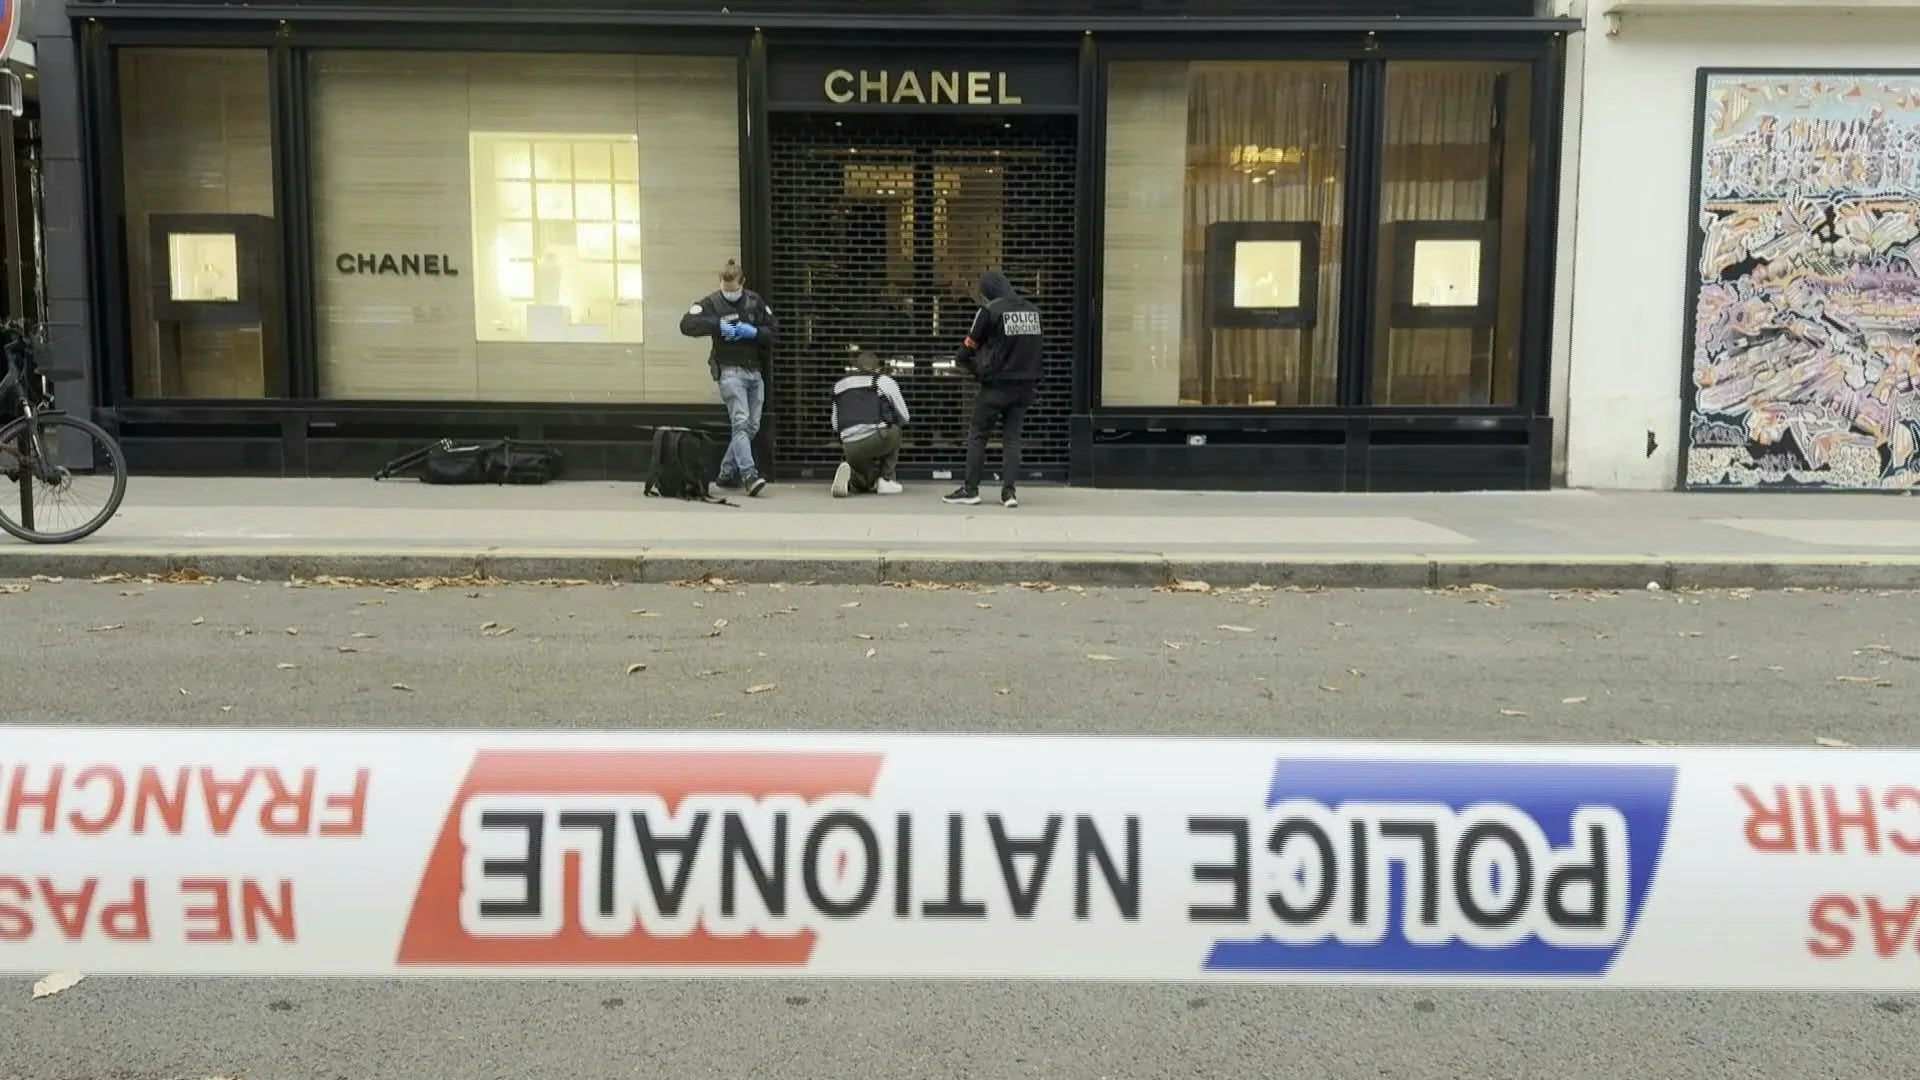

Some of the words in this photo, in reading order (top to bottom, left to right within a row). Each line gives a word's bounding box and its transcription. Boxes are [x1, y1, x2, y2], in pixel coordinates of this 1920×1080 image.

[824, 69, 1022, 104] CHANEL
[336, 253, 458, 275] CHANEL
[1004, 313, 1038, 323] POLICE
[0, 764, 369, 836] FRANCH
[480, 810, 1142, 920] NATIONALE
[1187, 815, 1607, 930] POLICE
[0, 875, 151, 942] PAS
[179, 876, 297, 944] NE
[1806, 893, 1920, 959] AS
